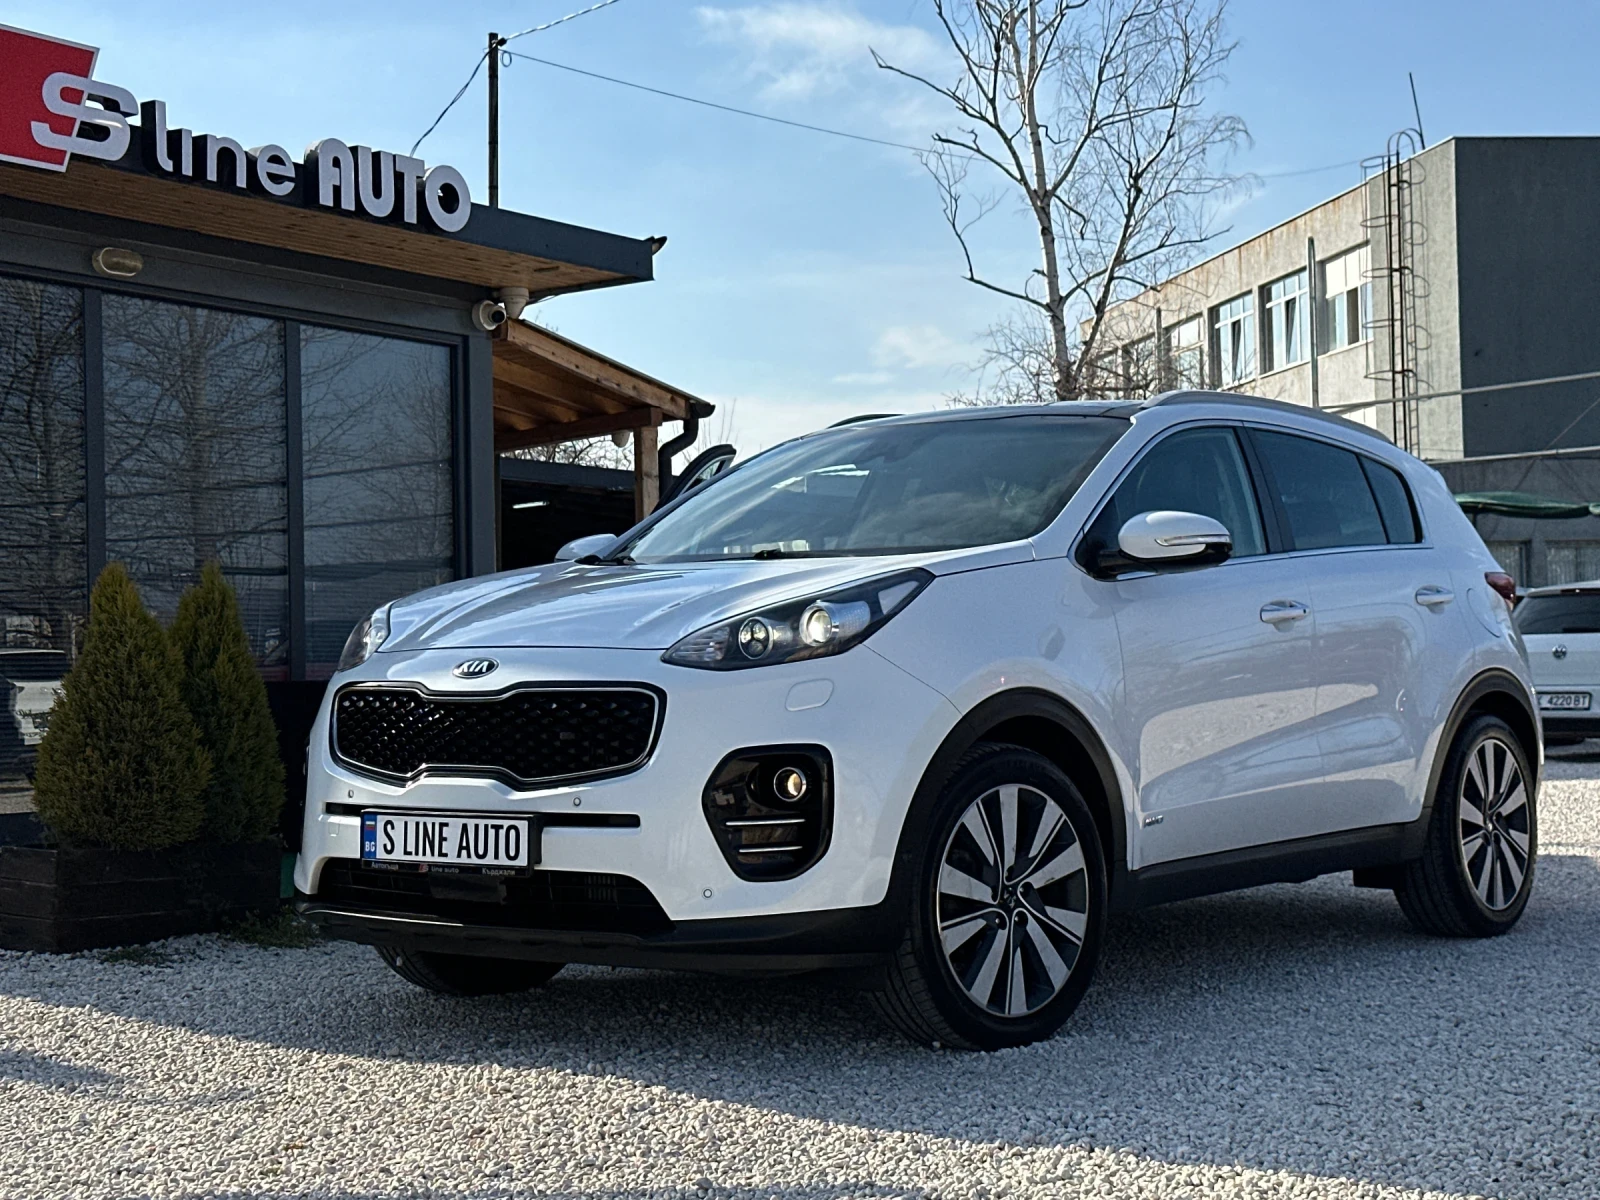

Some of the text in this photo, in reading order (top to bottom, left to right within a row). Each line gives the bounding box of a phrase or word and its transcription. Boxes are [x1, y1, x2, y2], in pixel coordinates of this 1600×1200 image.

[31, 72, 139, 161] S
[316, 138, 471, 232] AUTO
[459, 660, 489, 673] KIA
[365, 841, 375, 852] BG
[383, 820, 521, 861] S LINE AUTO
